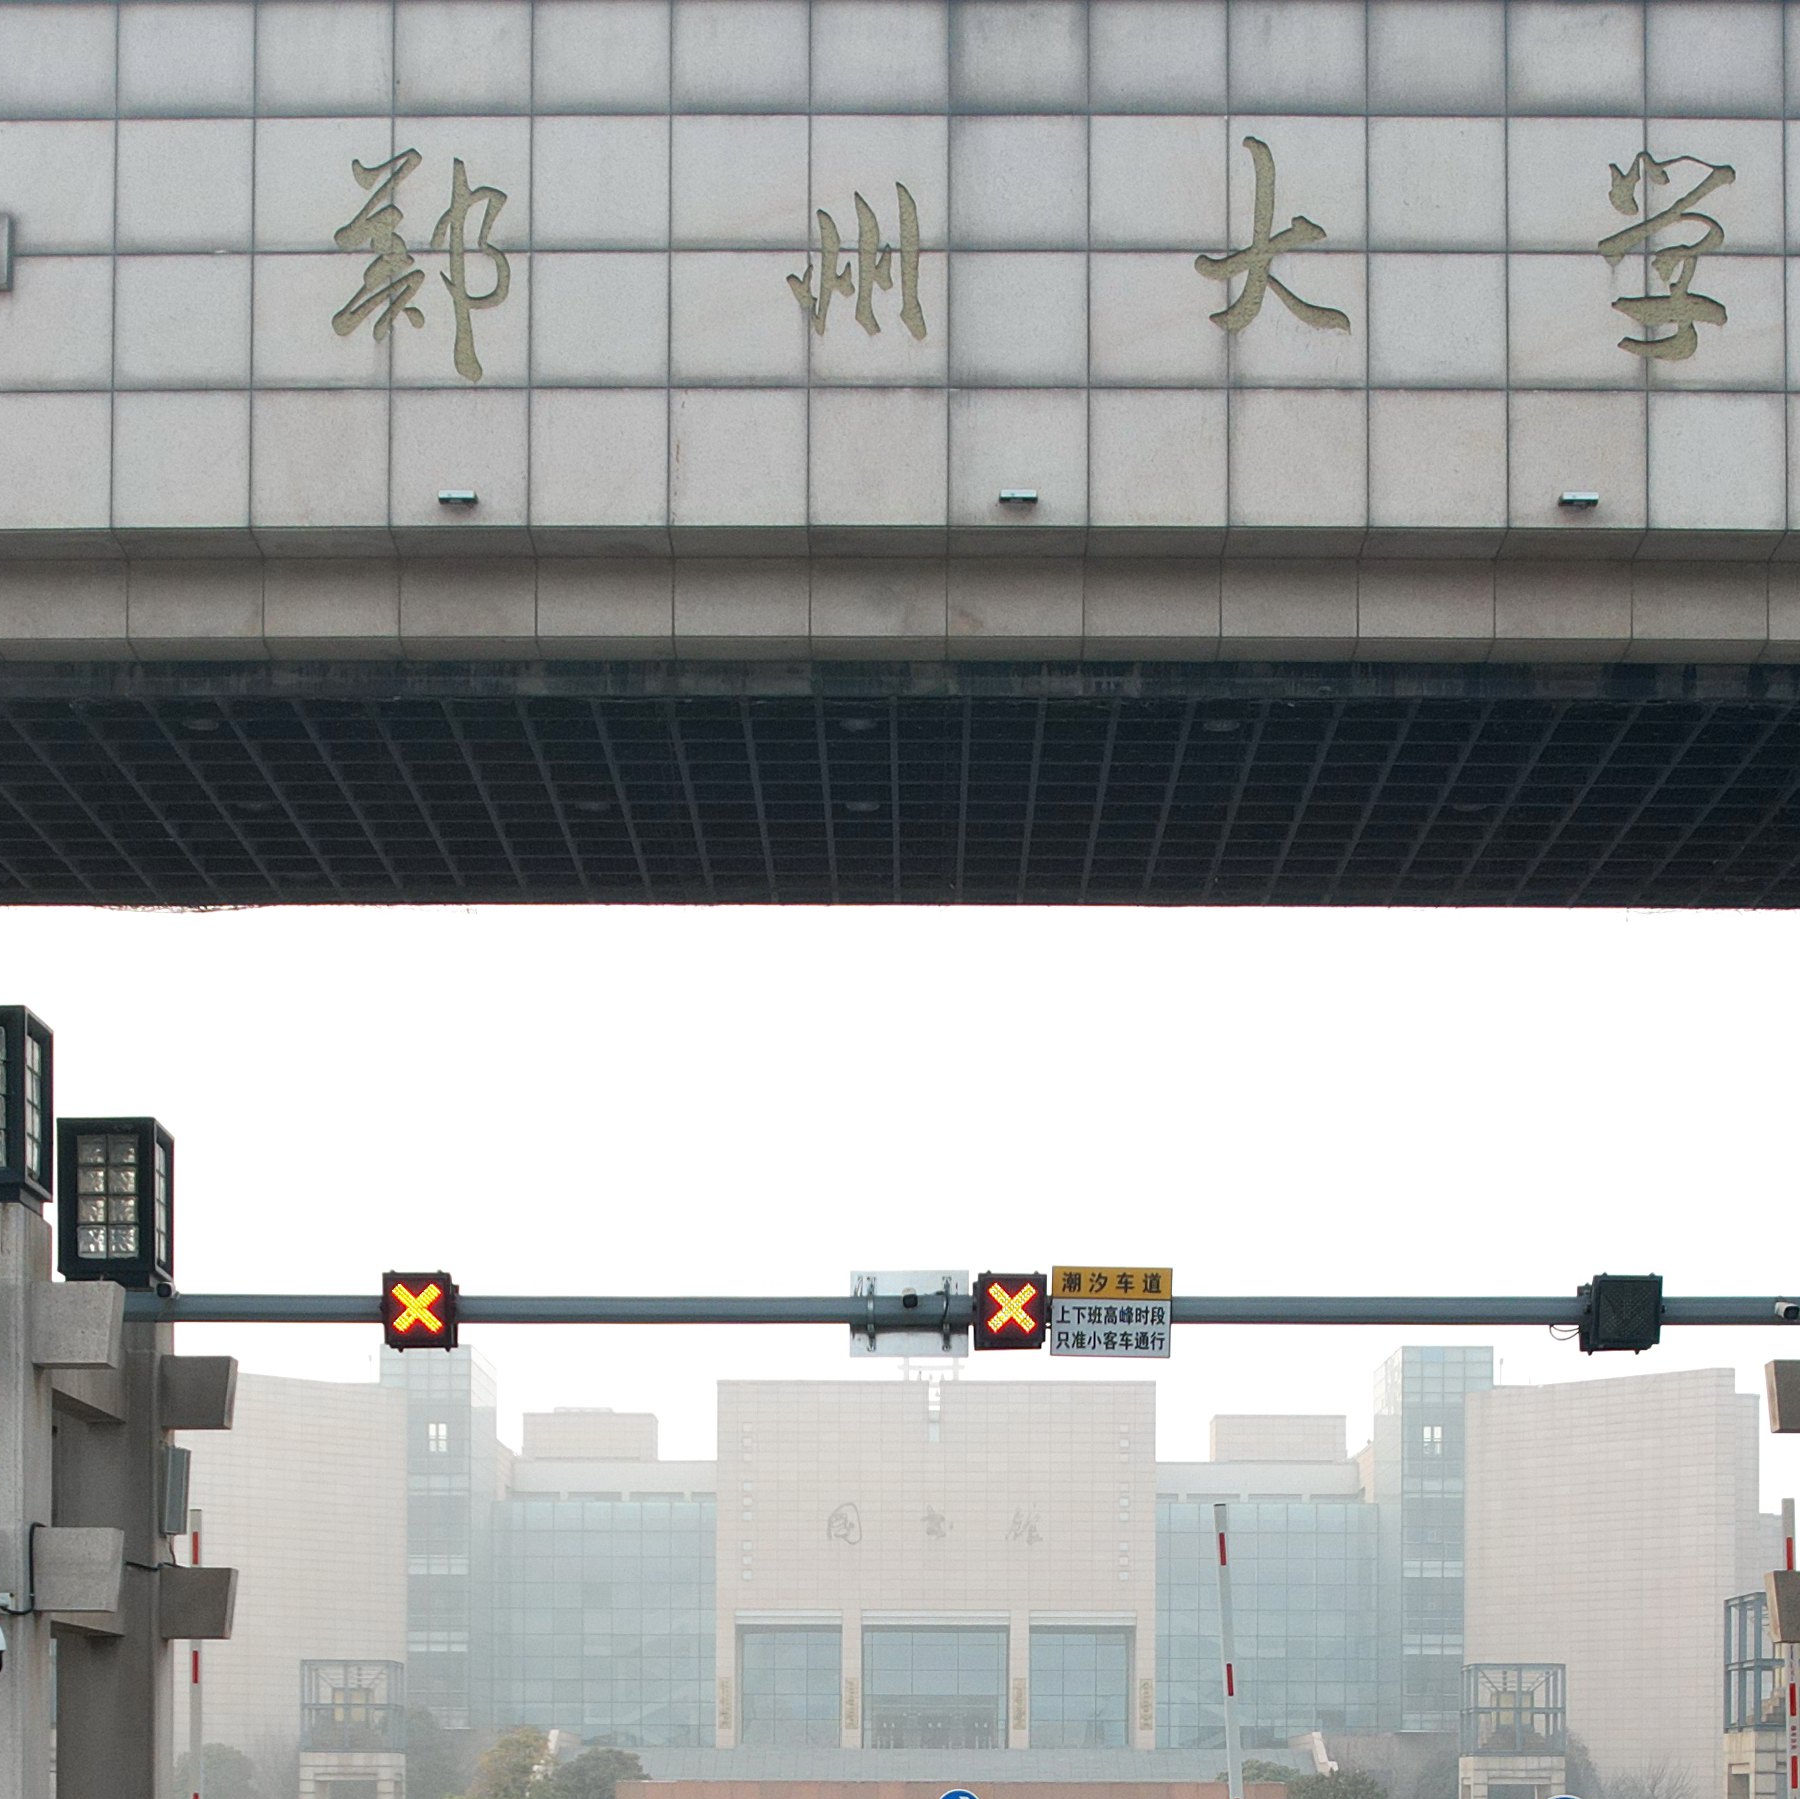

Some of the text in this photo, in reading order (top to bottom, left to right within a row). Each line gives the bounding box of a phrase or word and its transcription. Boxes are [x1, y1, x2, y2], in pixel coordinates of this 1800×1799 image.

[1062, 1272, 1162, 1293] 潮汐车道
[1057, 1306, 1165, 1325] 上下班高峰时段
[1056, 1331, 1165, 1351] 只准小客车通行
